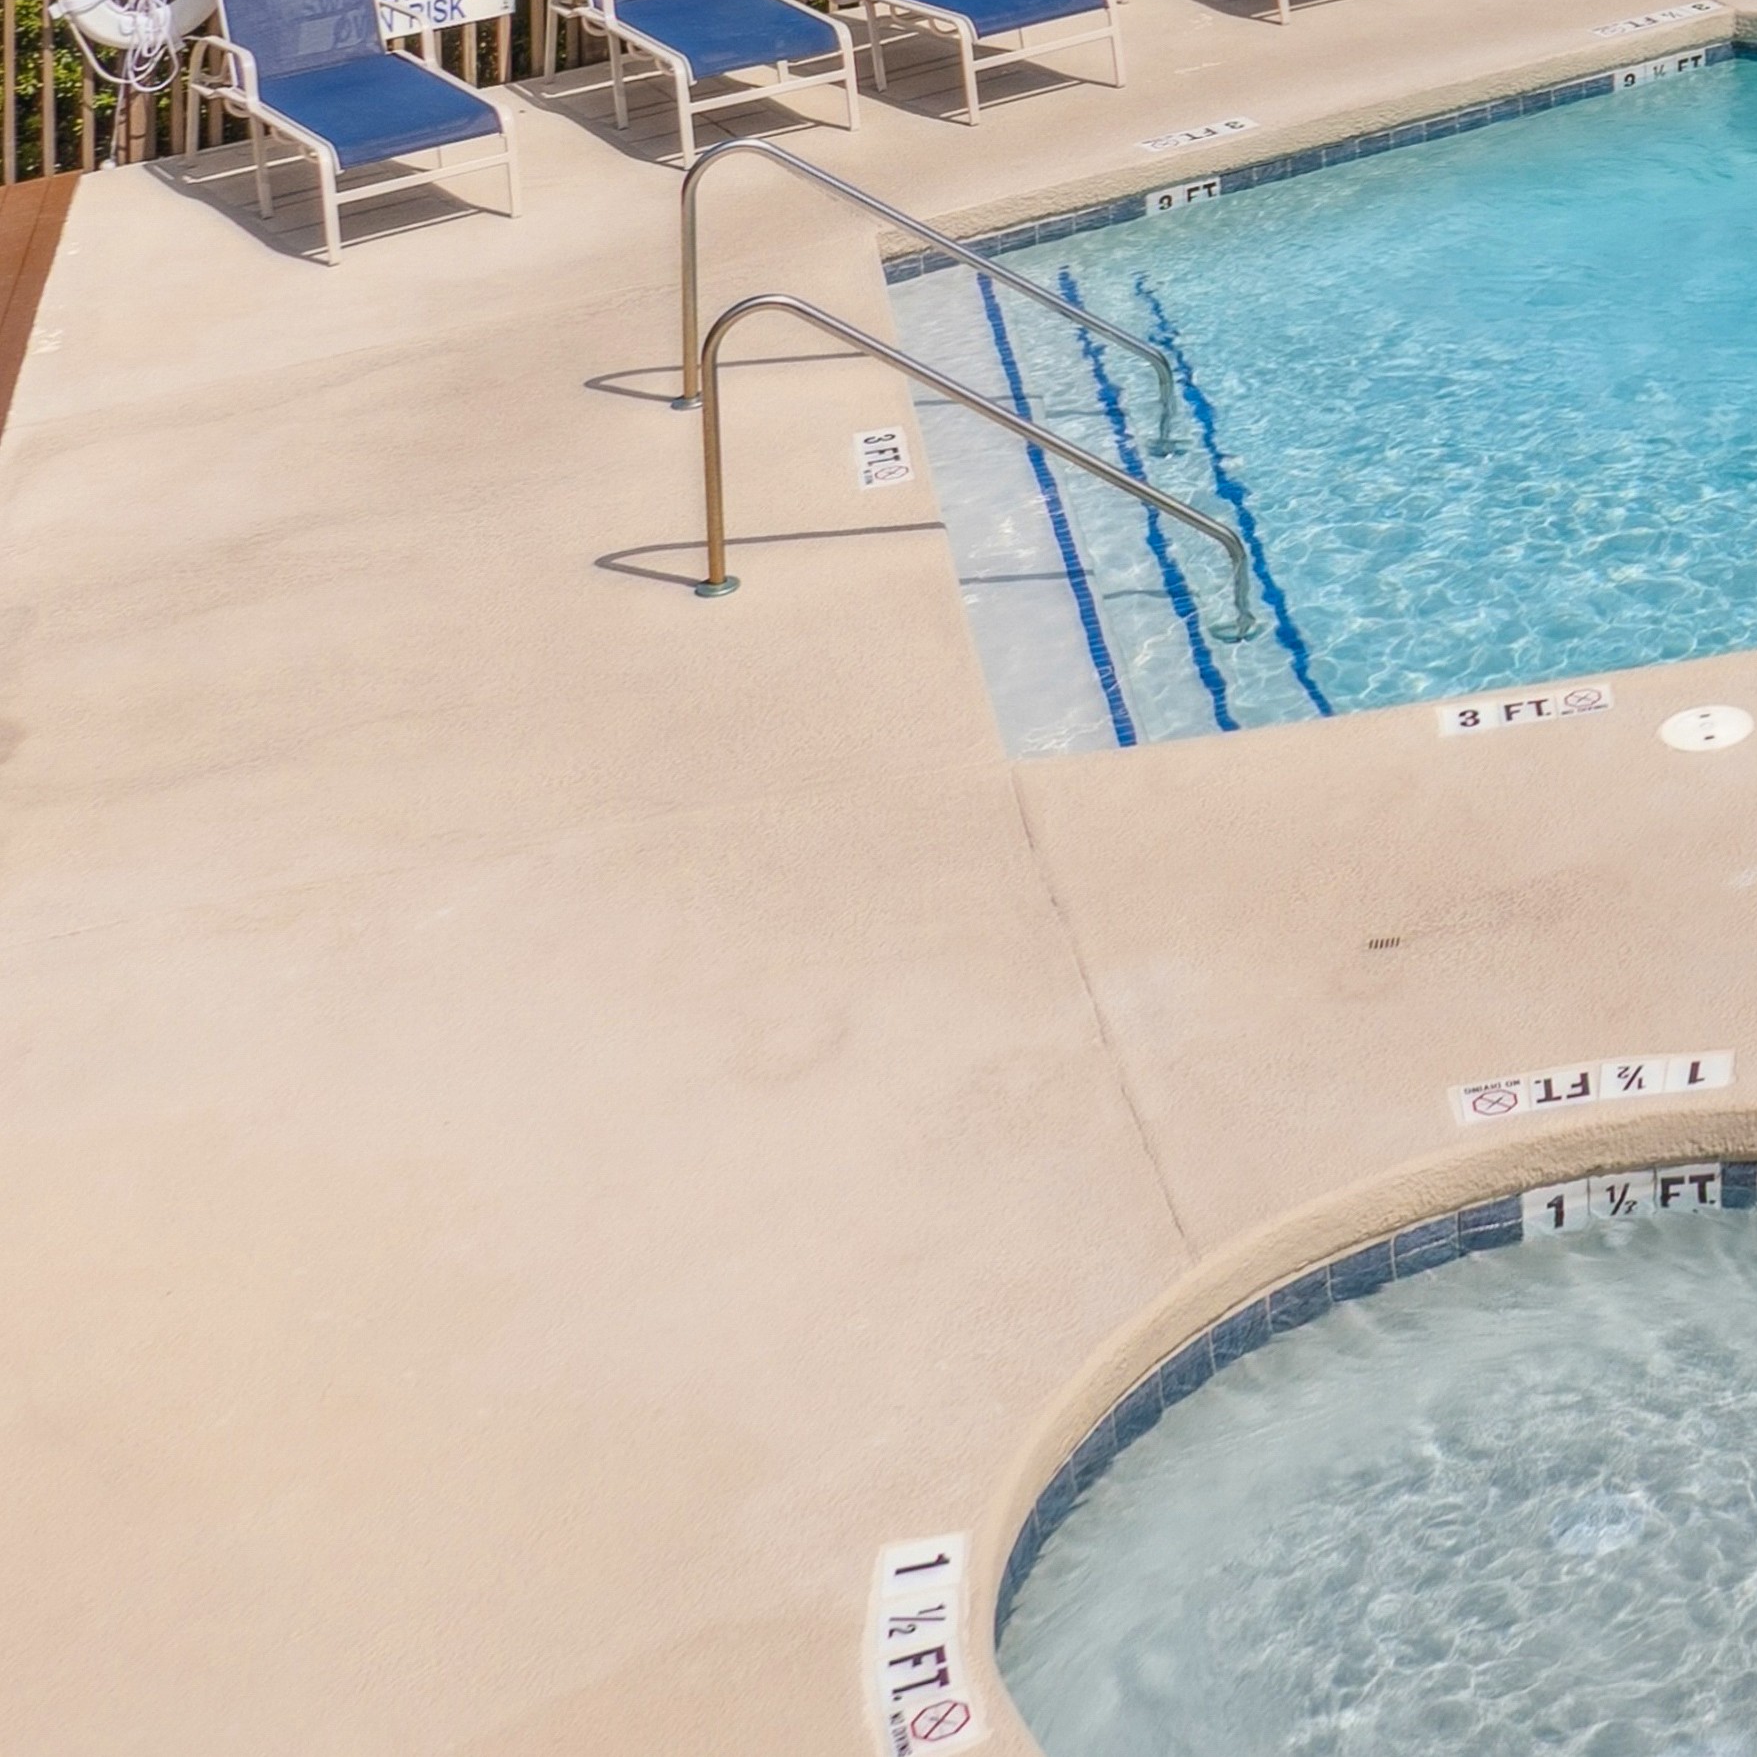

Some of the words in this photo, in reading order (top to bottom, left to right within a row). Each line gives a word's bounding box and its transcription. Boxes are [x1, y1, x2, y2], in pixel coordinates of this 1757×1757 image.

[863, 434, 896, 444] 3
[1458, 709, 1480, 727] 3
[1687, 1061, 1705, 1085] 1
[1547, 1194, 1565, 1229] 1
[895, 1553, 950, 1576] 1
